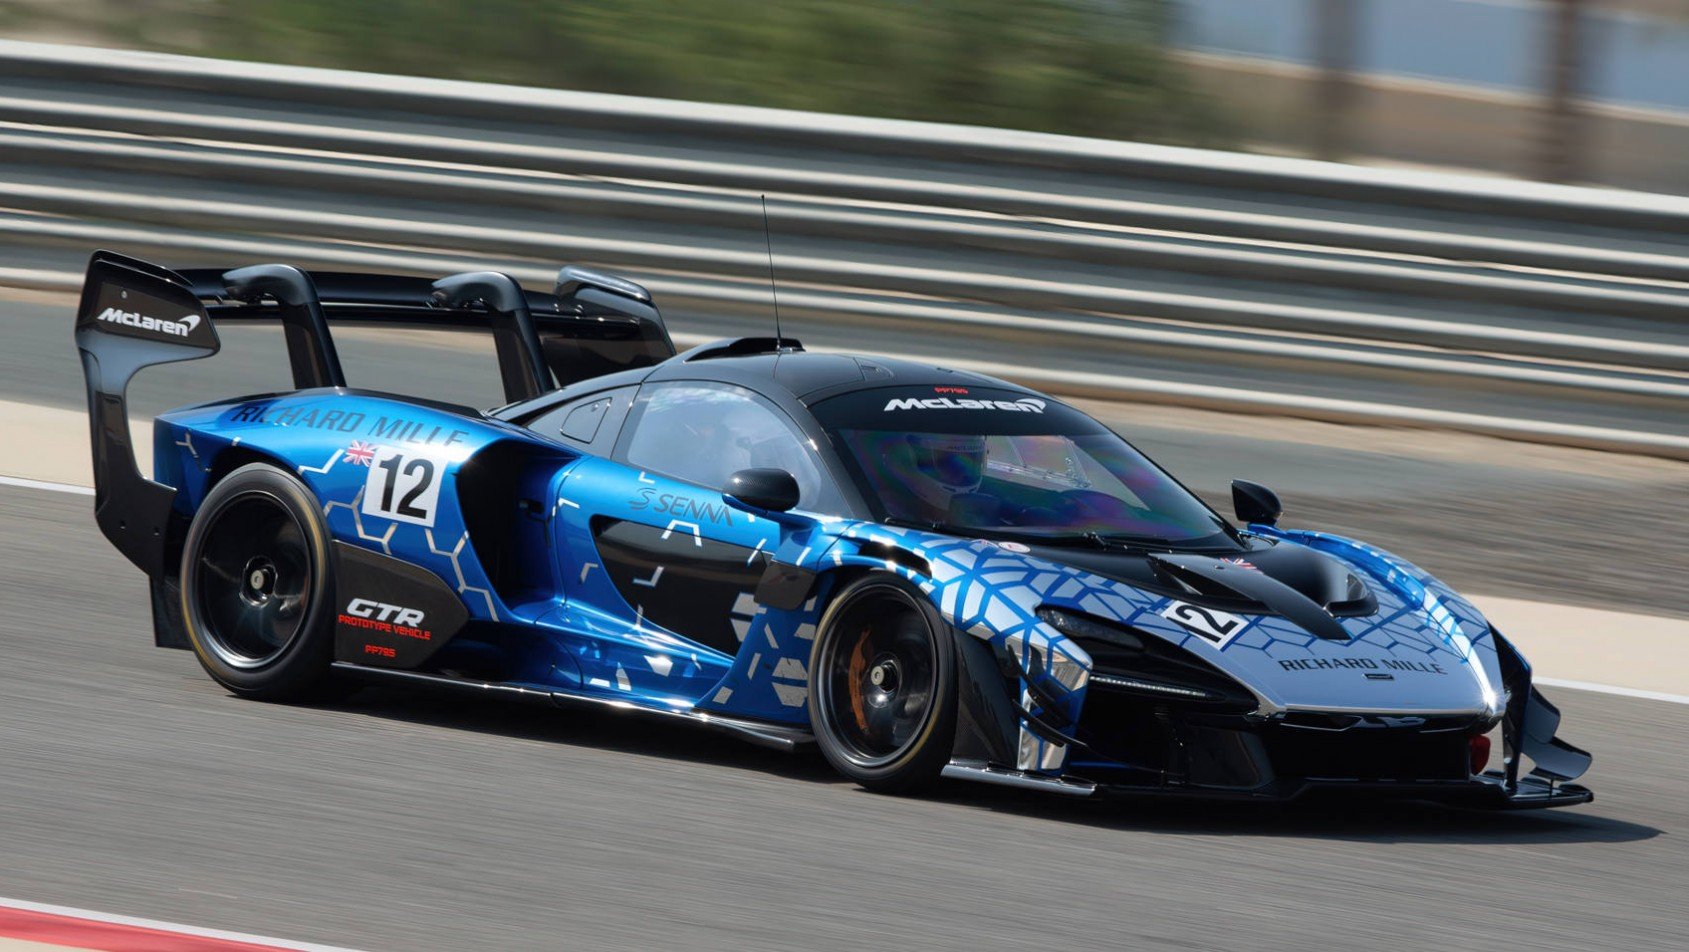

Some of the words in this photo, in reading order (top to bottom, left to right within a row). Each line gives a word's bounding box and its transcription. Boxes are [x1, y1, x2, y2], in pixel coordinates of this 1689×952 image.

[98, 307, 190, 337] McLaren
[884, 397, 1044, 414] McLaren
[378, 453, 435, 520] 12
[654, 493, 734, 527] SENNA
[338, 614, 392, 633] PROTOTYPE
[393, 624, 432, 641] VEHICLE
[346, 598, 425, 628] GTR
[1166, 604, 1239, 643] 12
[364, 644, 397, 658] PP795
[1278, 657, 1379, 672] RICHARD
[1381, 658, 1448, 675] MILLE
